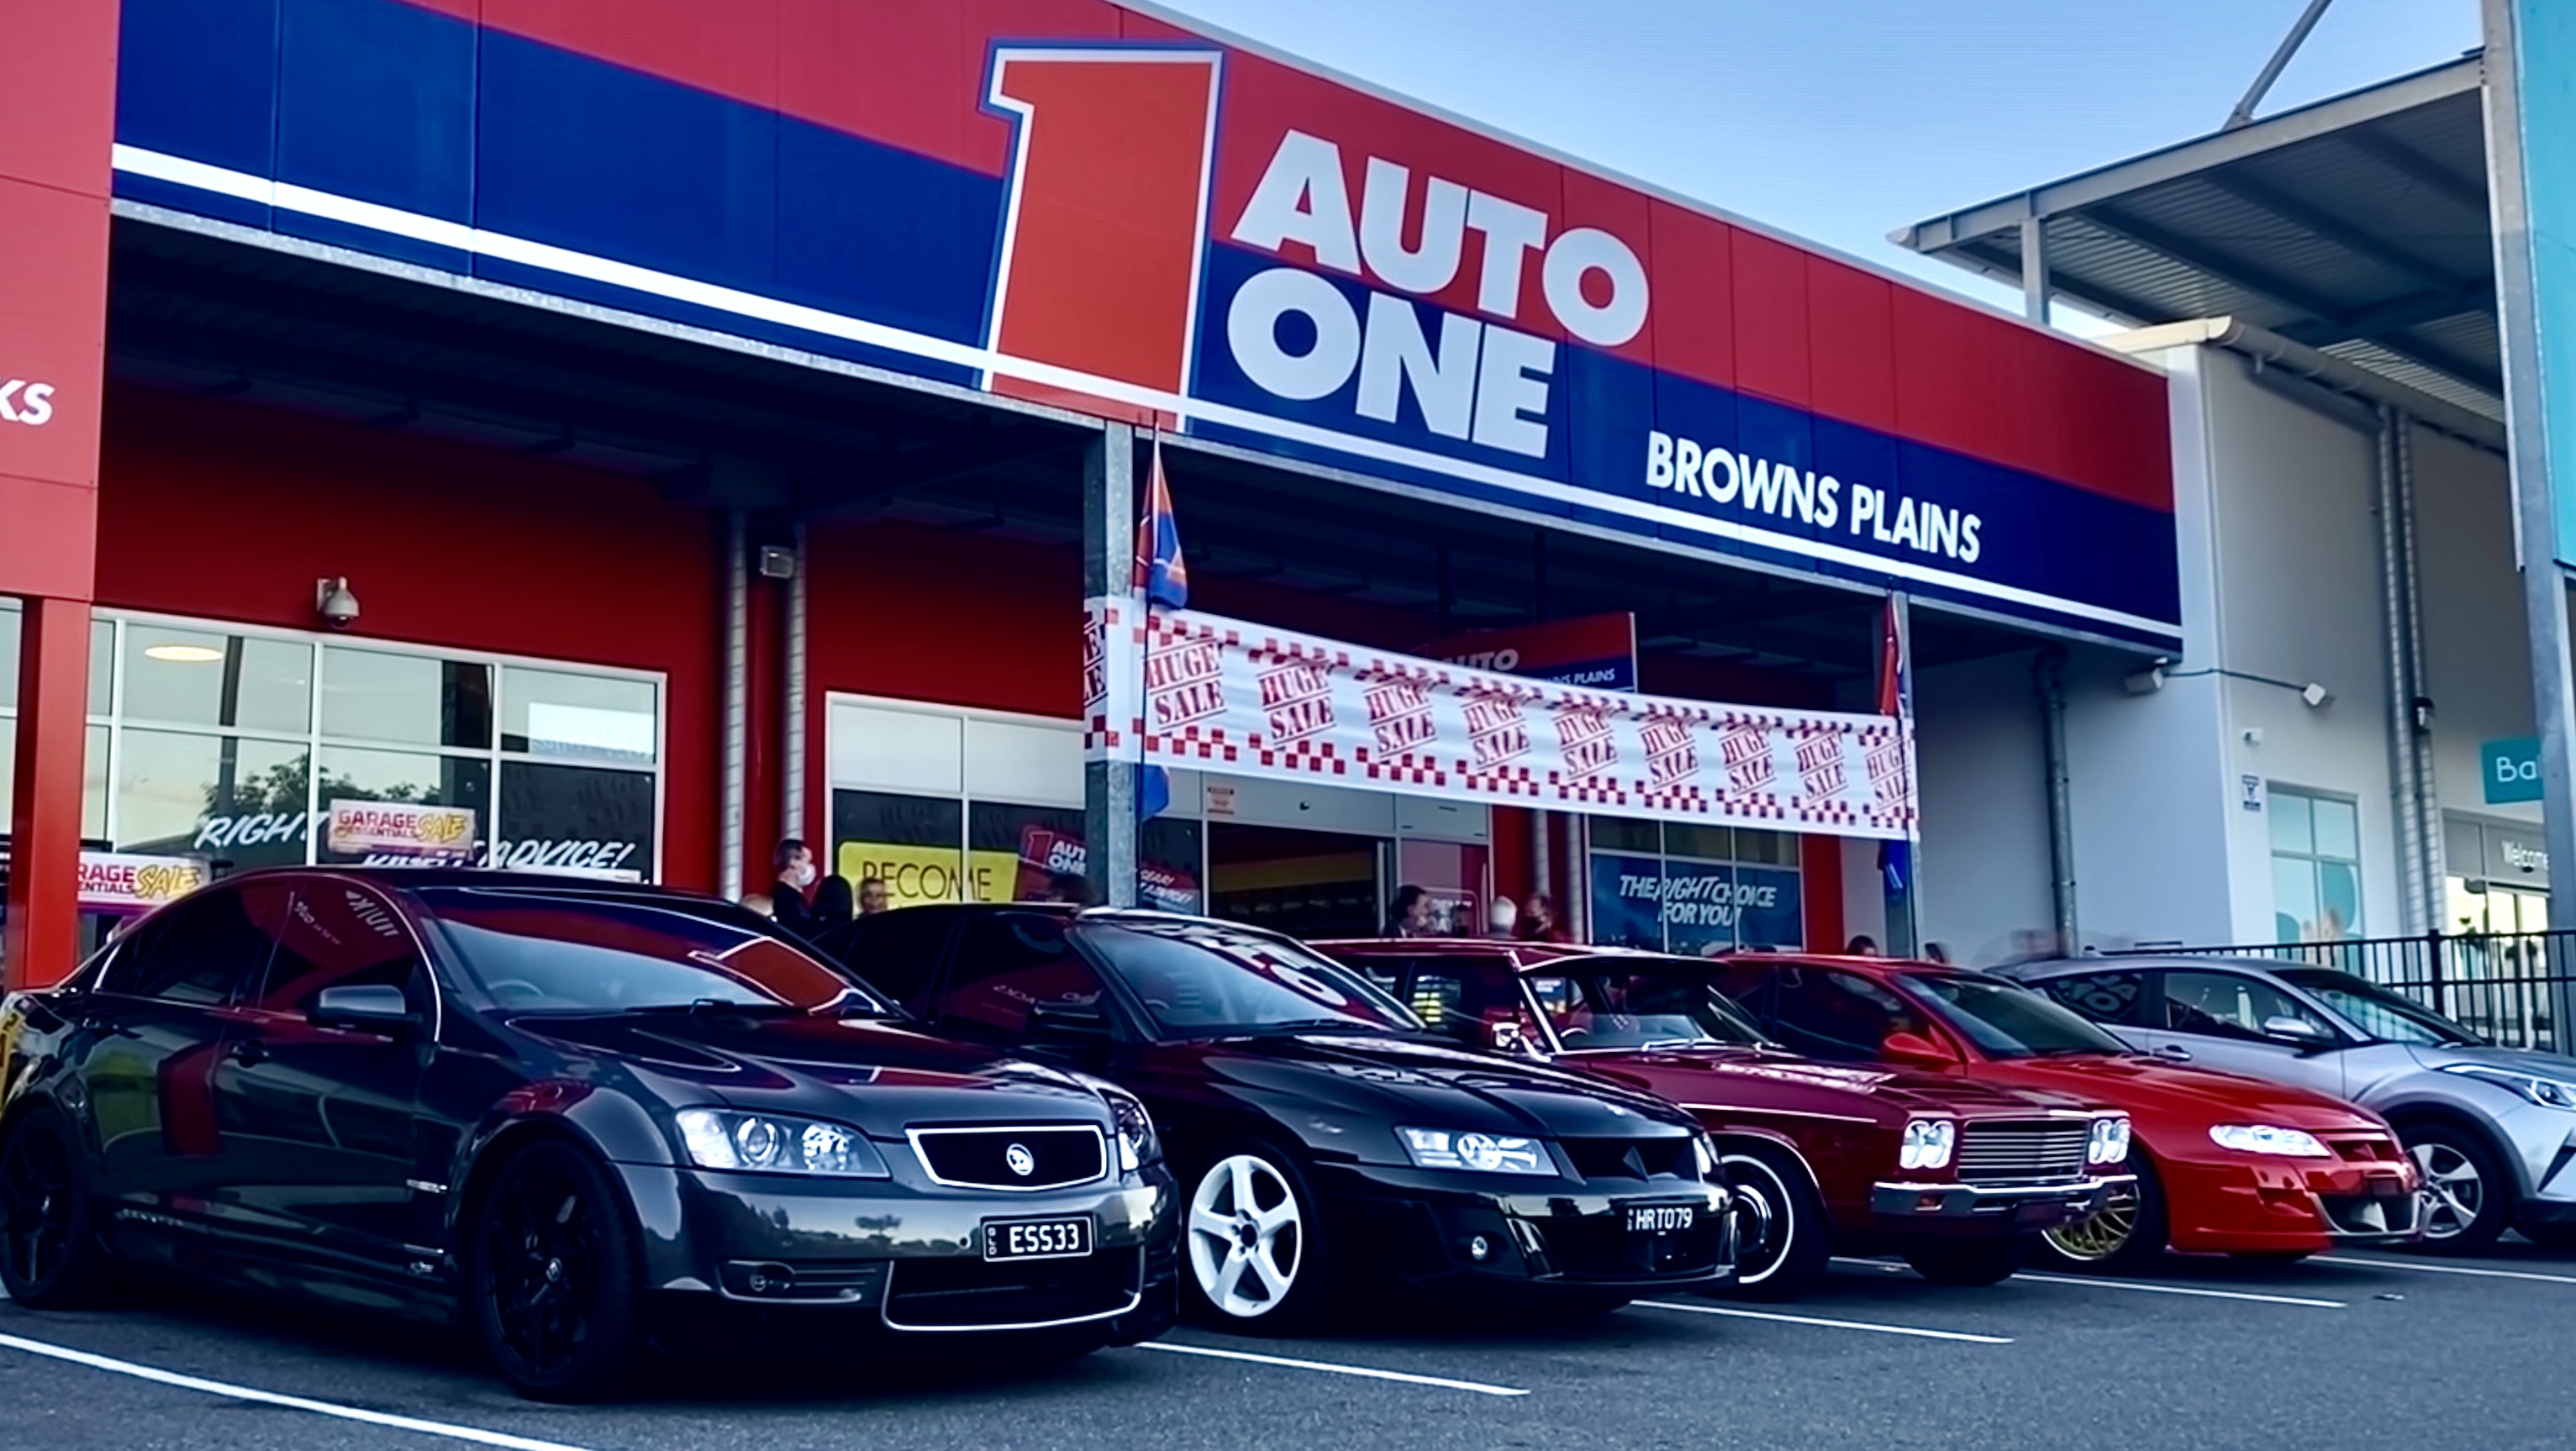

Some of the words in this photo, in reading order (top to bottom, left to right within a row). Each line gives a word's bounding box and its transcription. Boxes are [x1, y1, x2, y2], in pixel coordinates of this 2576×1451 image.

[1230, 129, 1650, 347] AUTO
[1227, 266, 1557, 459] ONE
[1646, 429, 1841, 528] BROWNS
[1850, 483, 1983, 564] PLAINS
[1146, 643, 1220, 689] HUGE
[1572, 668, 1616, 685] PLAINS
[1154, 681, 1225, 725] SALE
[1258, 666, 1329, 706] HUGE
[1364, 684, 1430, 722] HUGE
[1270, 697, 1335, 739] SALE
[1374, 712, 1436, 753] SALE
[1462, 701, 1523, 734] HUGE
[1555, 712, 1609, 746] HUGE
[1472, 725, 1530, 765] SALE
[1563, 736, 1618, 775] SALE
[1641, 721, 1694, 755] HUGE
[1721, 729, 1771, 765] HUGE
[1795, 732, 1842, 773] HUGE
[1648, 746, 1699, 785] SALE
[1728, 754, 1775, 793] SALE
[1804, 762, 1848, 800] SALE
[338, 810, 419, 829] GARAGE
[416, 812, 468, 844] SALE
[133, 863, 202, 900] SALE
[1620, 875, 1657, 899] THE
[1652, 875, 1720, 902] RIGHT
[1710, 882, 1778, 907] CHOICE
[1657, 901, 1698, 924] FOR
[1009, 1223, 1079, 1254] ESS33
